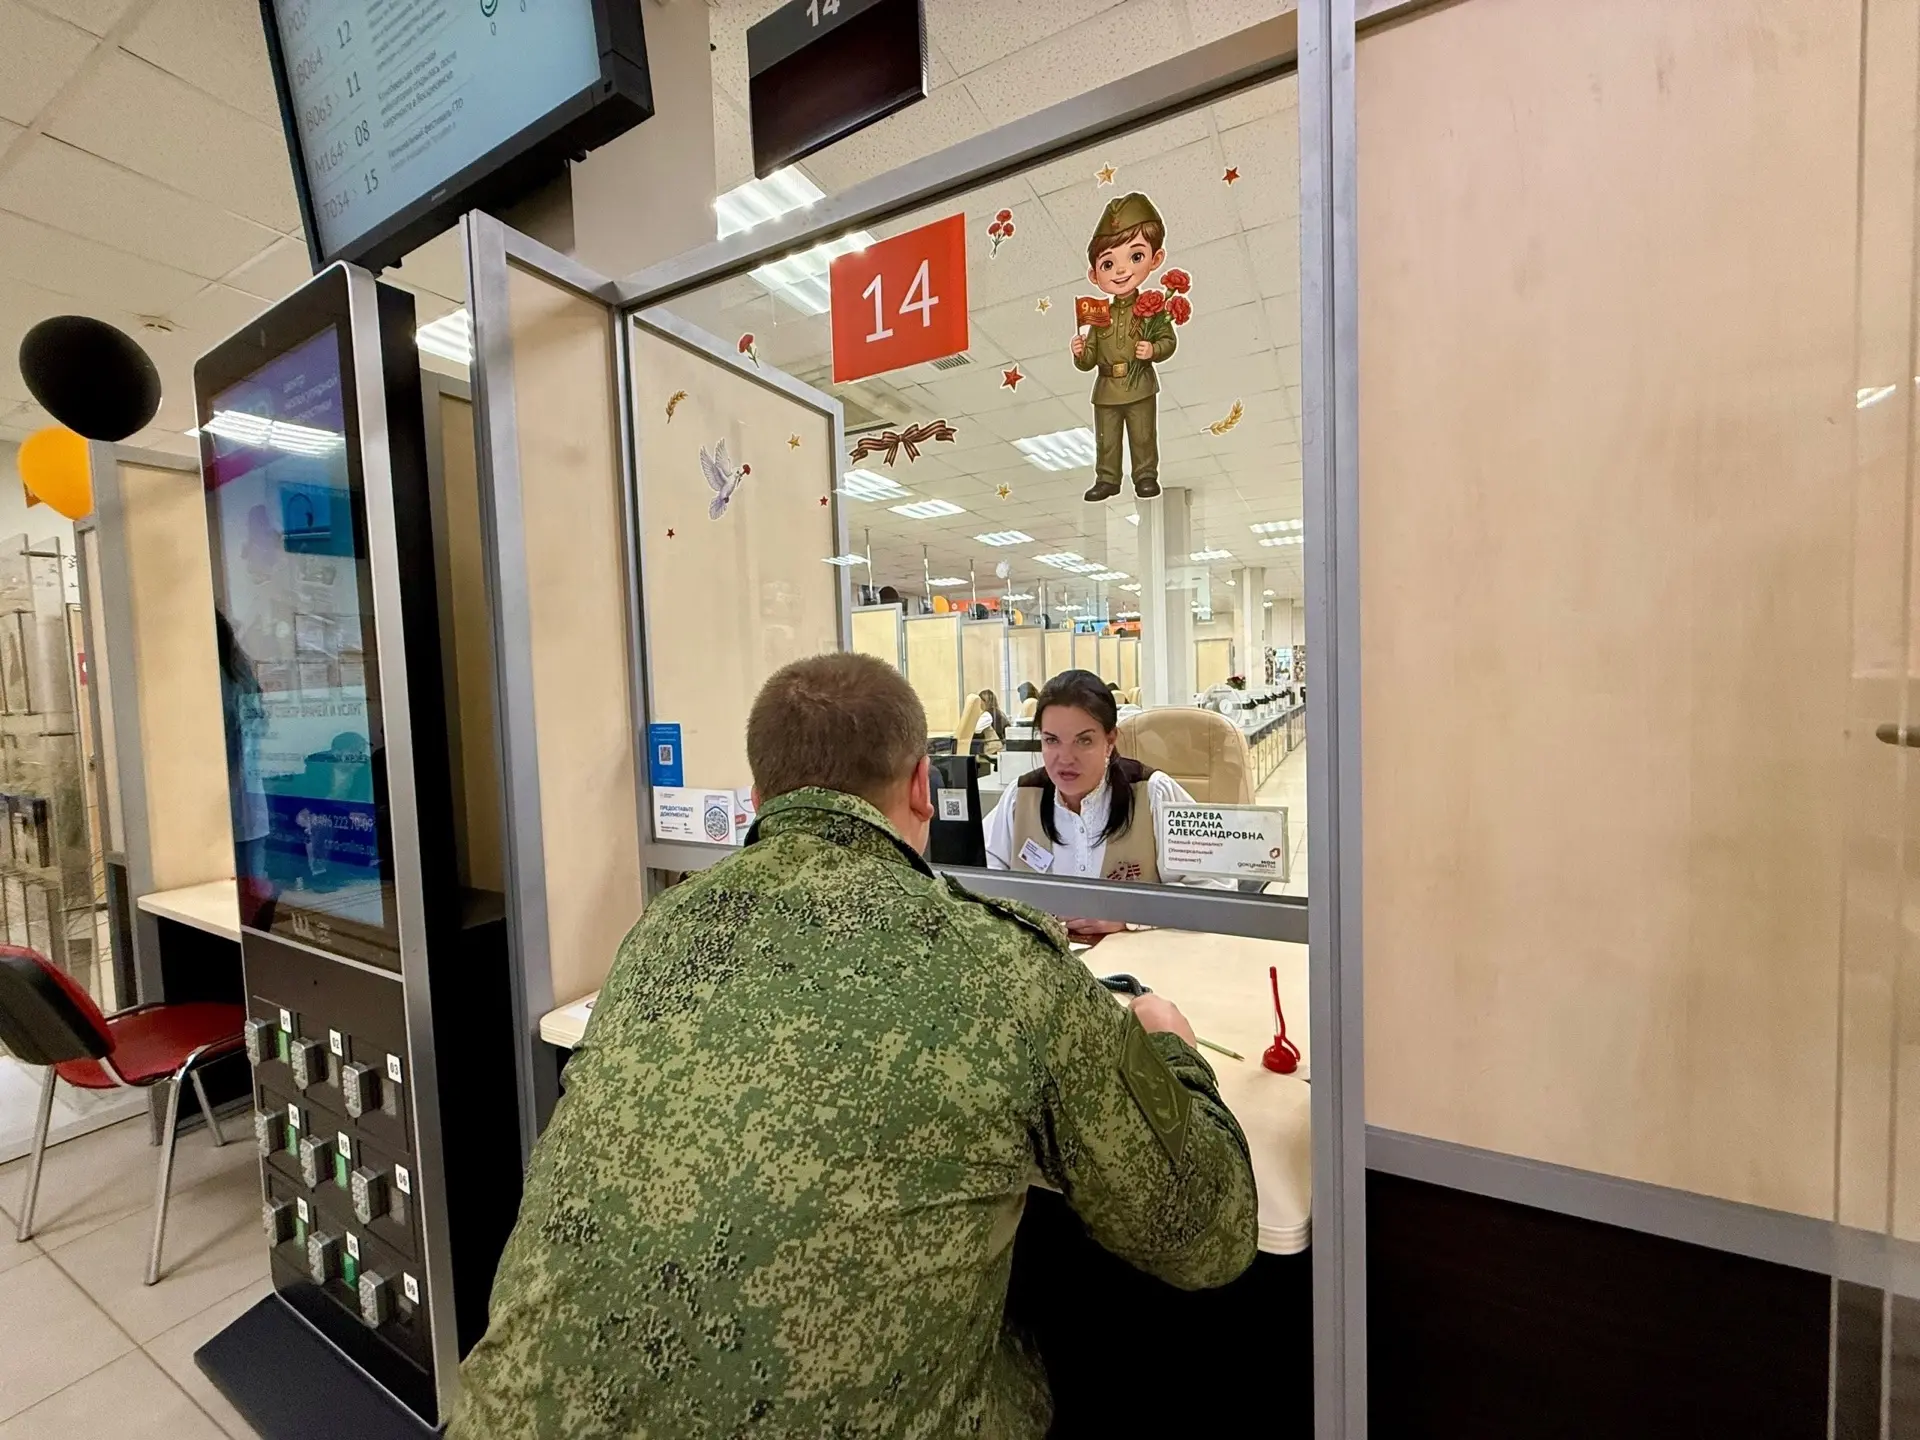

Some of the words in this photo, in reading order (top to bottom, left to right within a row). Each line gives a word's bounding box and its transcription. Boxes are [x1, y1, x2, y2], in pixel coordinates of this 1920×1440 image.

[337, 20, 352, 49] 12
[346, 71, 361, 98] 11
[355, 119, 371, 147] 08
[364, 168, 379, 195] 15
[862, 259, 939, 343] 14
[1081, 301, 1089, 314] 9
[1090, 306, 1107, 314] МАЯ
[1168, 811, 1222, 820] ЛАЗАРЕВА
[1168, 820, 1223, 829] СВЕТЛАНА
[1168, 828, 1265, 840] АЛЕКСАНДРОВНА
[389, 1061, 399, 1076] 03
[398, 1172, 407, 1187] 06
